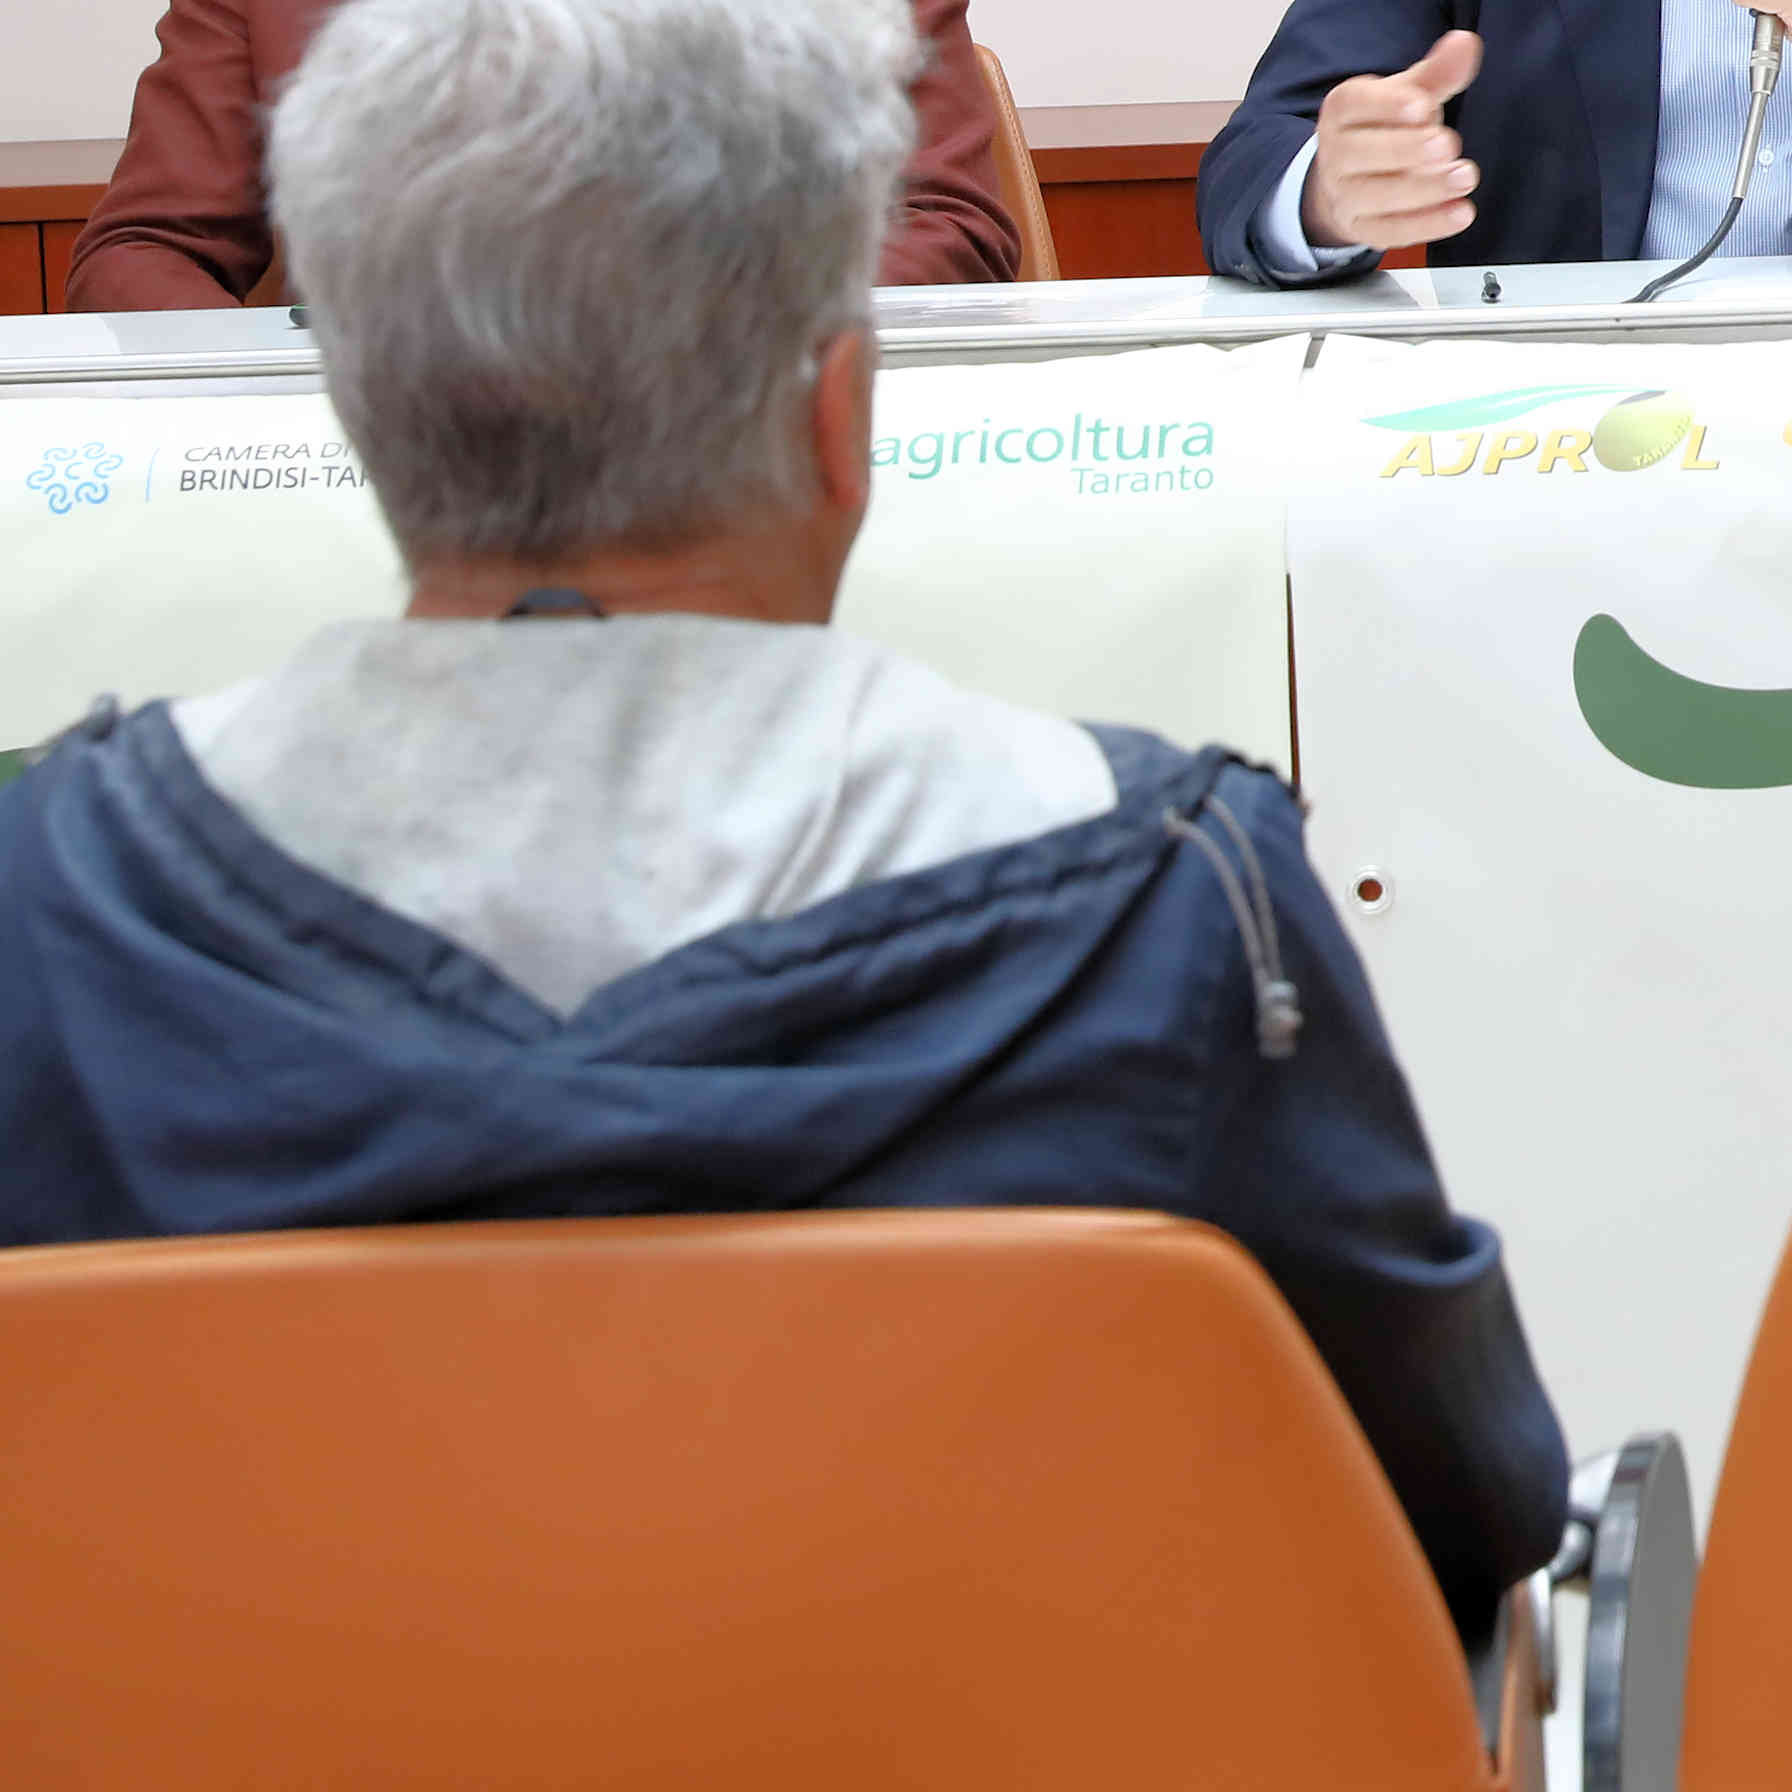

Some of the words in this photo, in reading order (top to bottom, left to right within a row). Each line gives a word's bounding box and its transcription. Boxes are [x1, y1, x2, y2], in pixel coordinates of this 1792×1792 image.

[1378, 390, 1720, 478] AJPROL
[183, 442, 311, 463] CAMERA
[1070, 464, 1214, 495] Taranto
